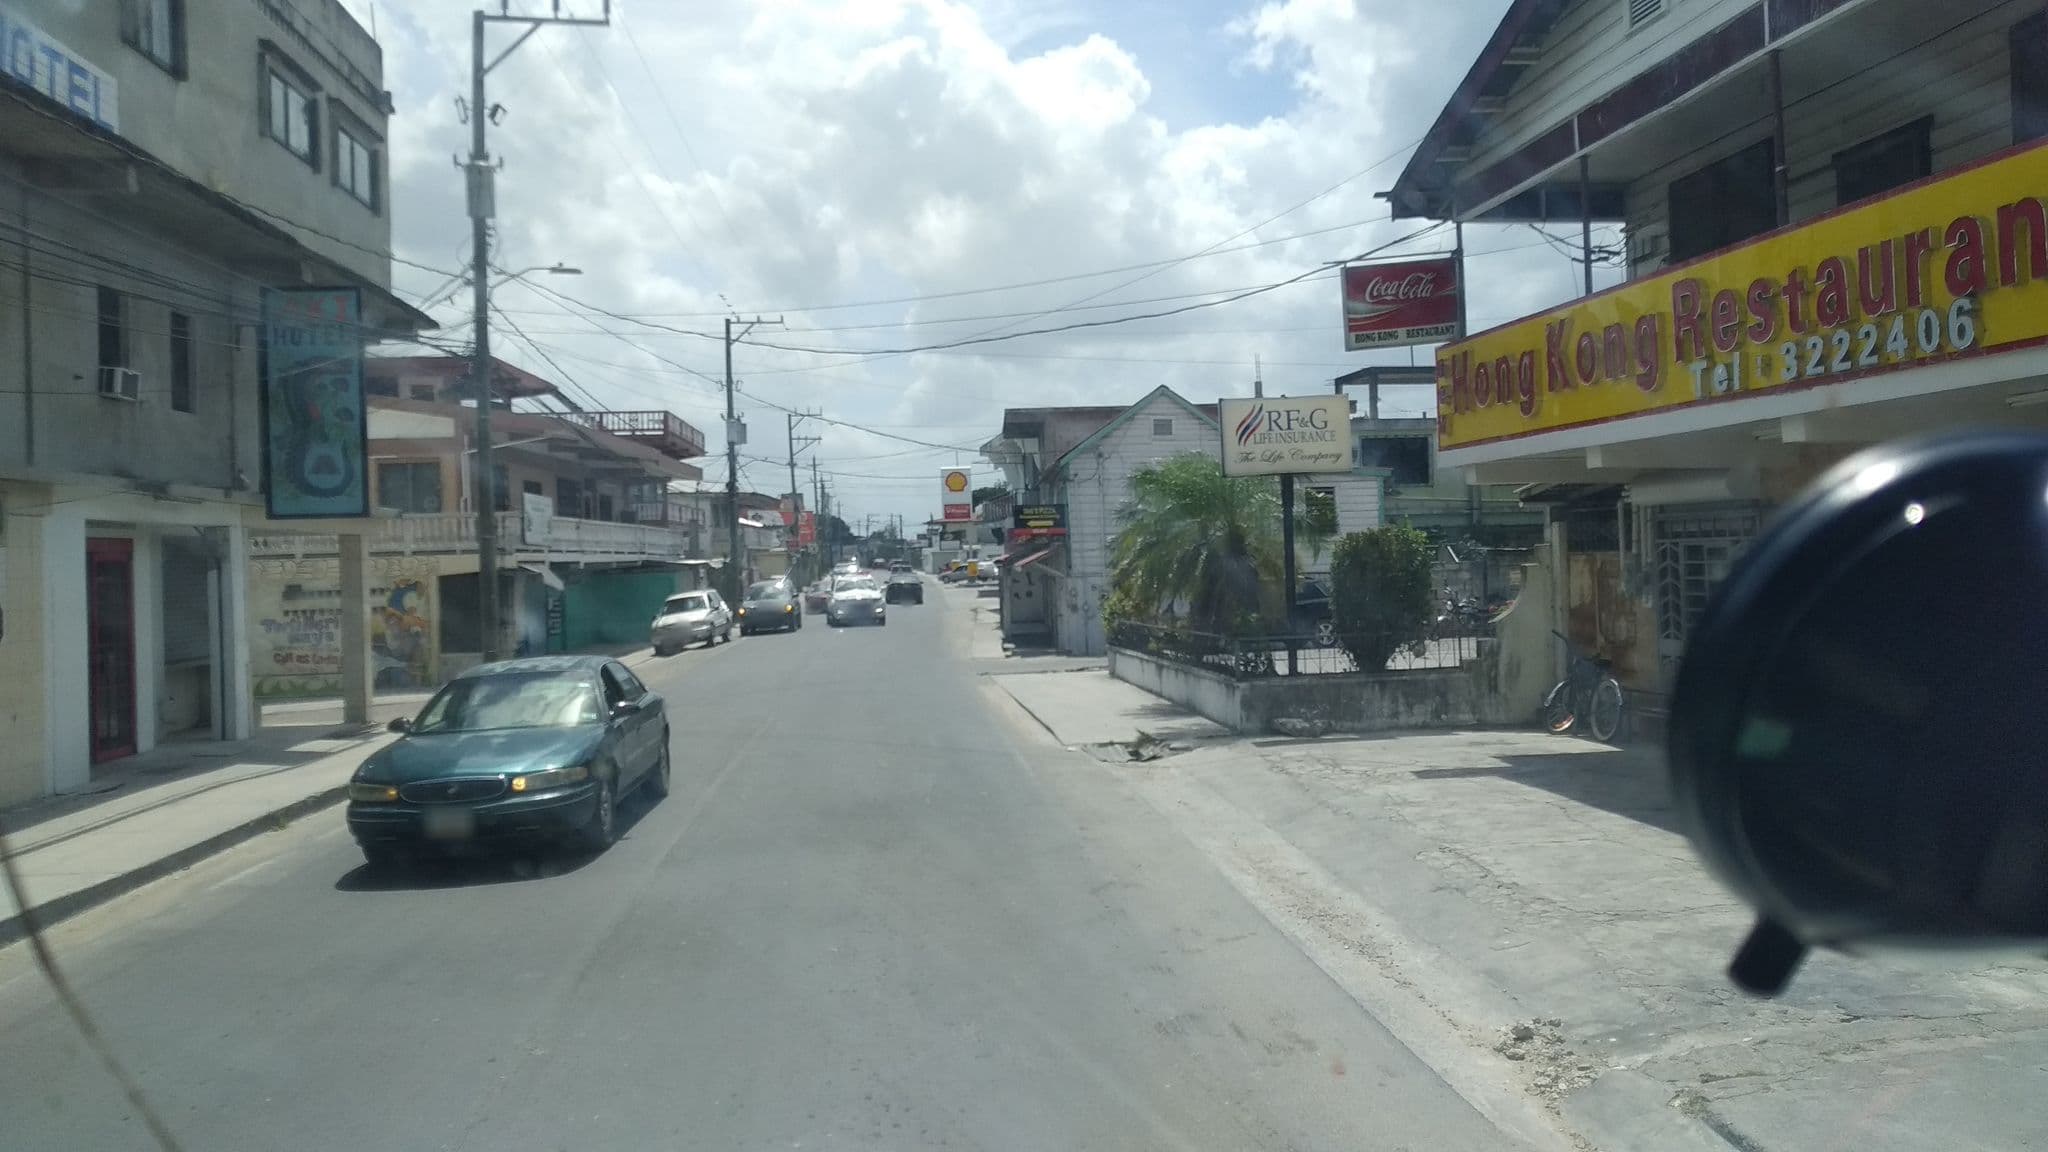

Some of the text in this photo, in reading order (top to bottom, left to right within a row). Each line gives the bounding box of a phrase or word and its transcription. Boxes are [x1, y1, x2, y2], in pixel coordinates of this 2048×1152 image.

[1365, 272, 1437, 303] Coca-Cola
[1355, 325, 1456, 344] HONG KONG RESTAURANT
[1780, 297, 1976, 382] 3222406
[1452, 350, 1536, 417] Hong
[1546, 314, 1659, 391] Kong
[1265, 408, 1328, 431] RF&G
[1253, 430, 1336, 444] LIFE INSURANCE
[1237, 448, 1343, 464] The Life Company
